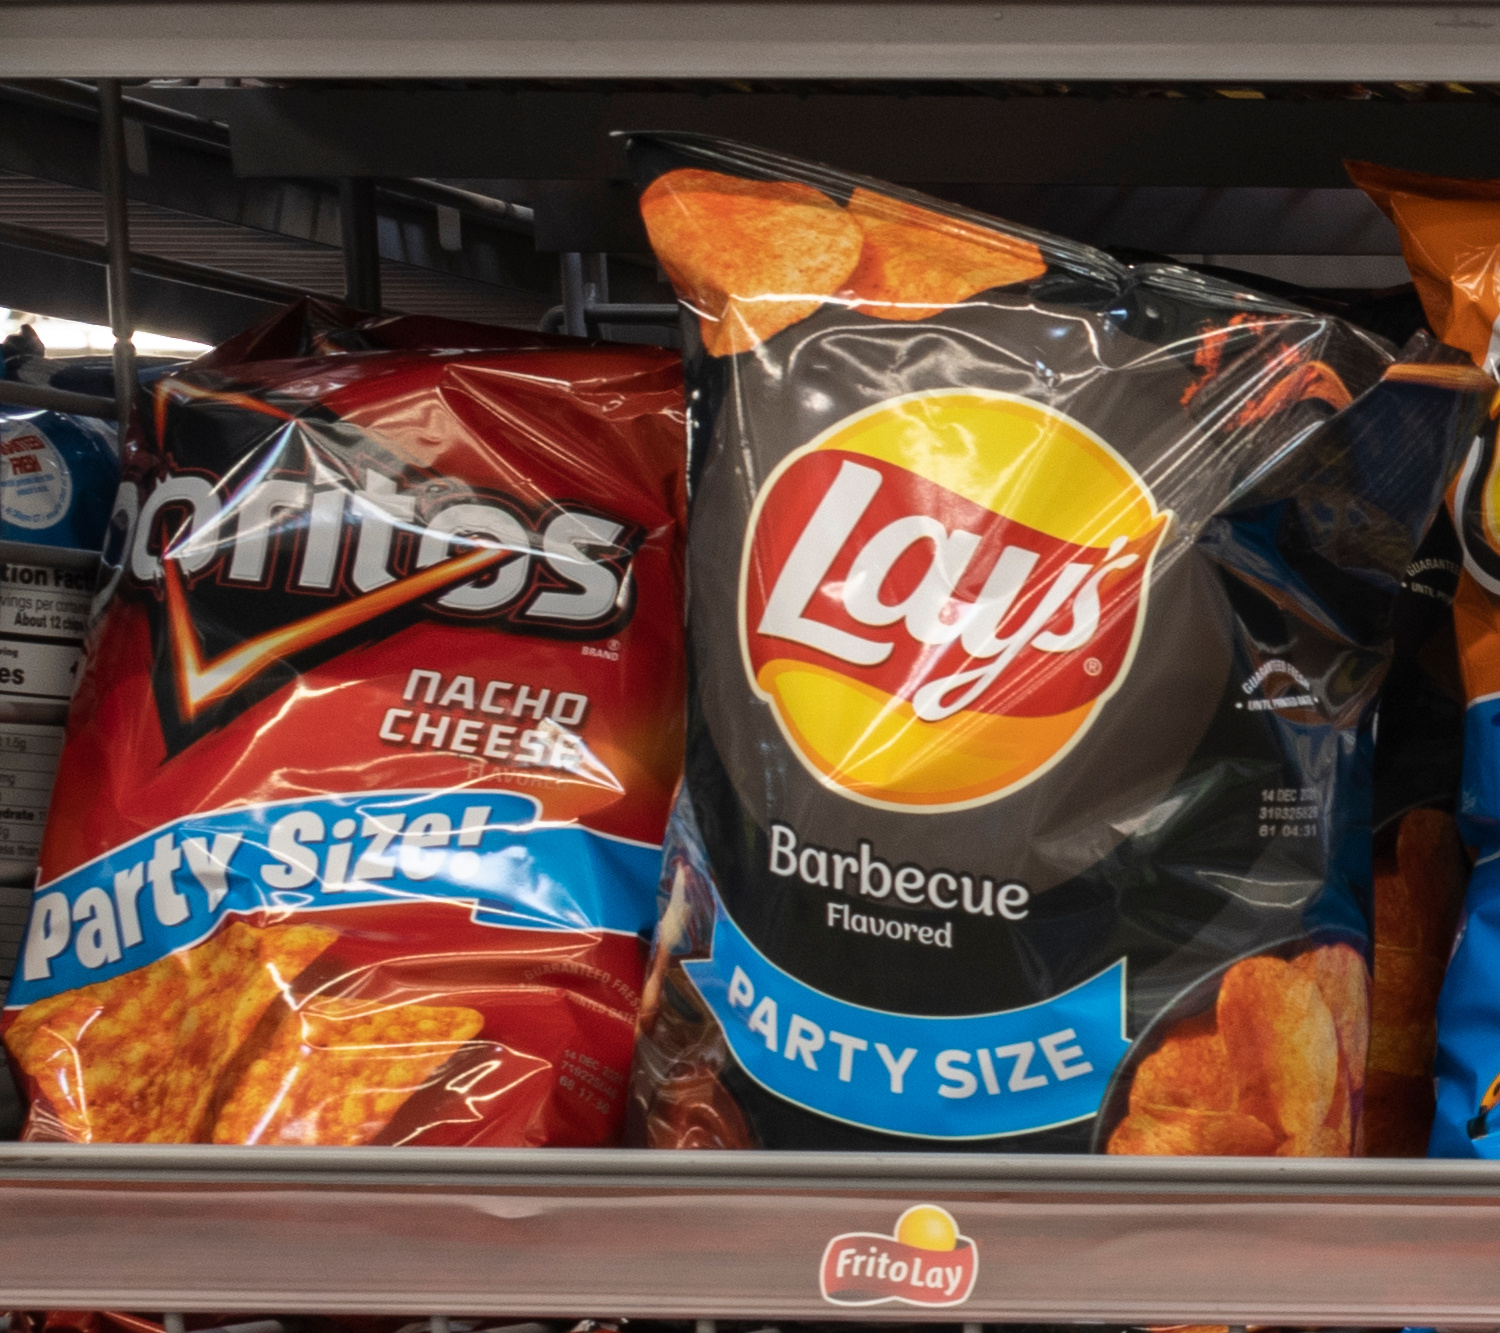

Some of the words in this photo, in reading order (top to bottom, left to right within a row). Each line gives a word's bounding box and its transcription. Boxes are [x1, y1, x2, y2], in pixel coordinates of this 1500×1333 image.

[758, 459, 1138, 721] Lay's
[403, 669, 589, 726] NACHO
[24, 826, 241, 980] Party
[261, 806, 491, 901] Size!
[769, 824, 1030, 920] Barbecue
[827, 903, 953, 948] Flavored
[728, 966, 918, 1094] PARTY
[935, 1028, 1094, 1098] SIZE
